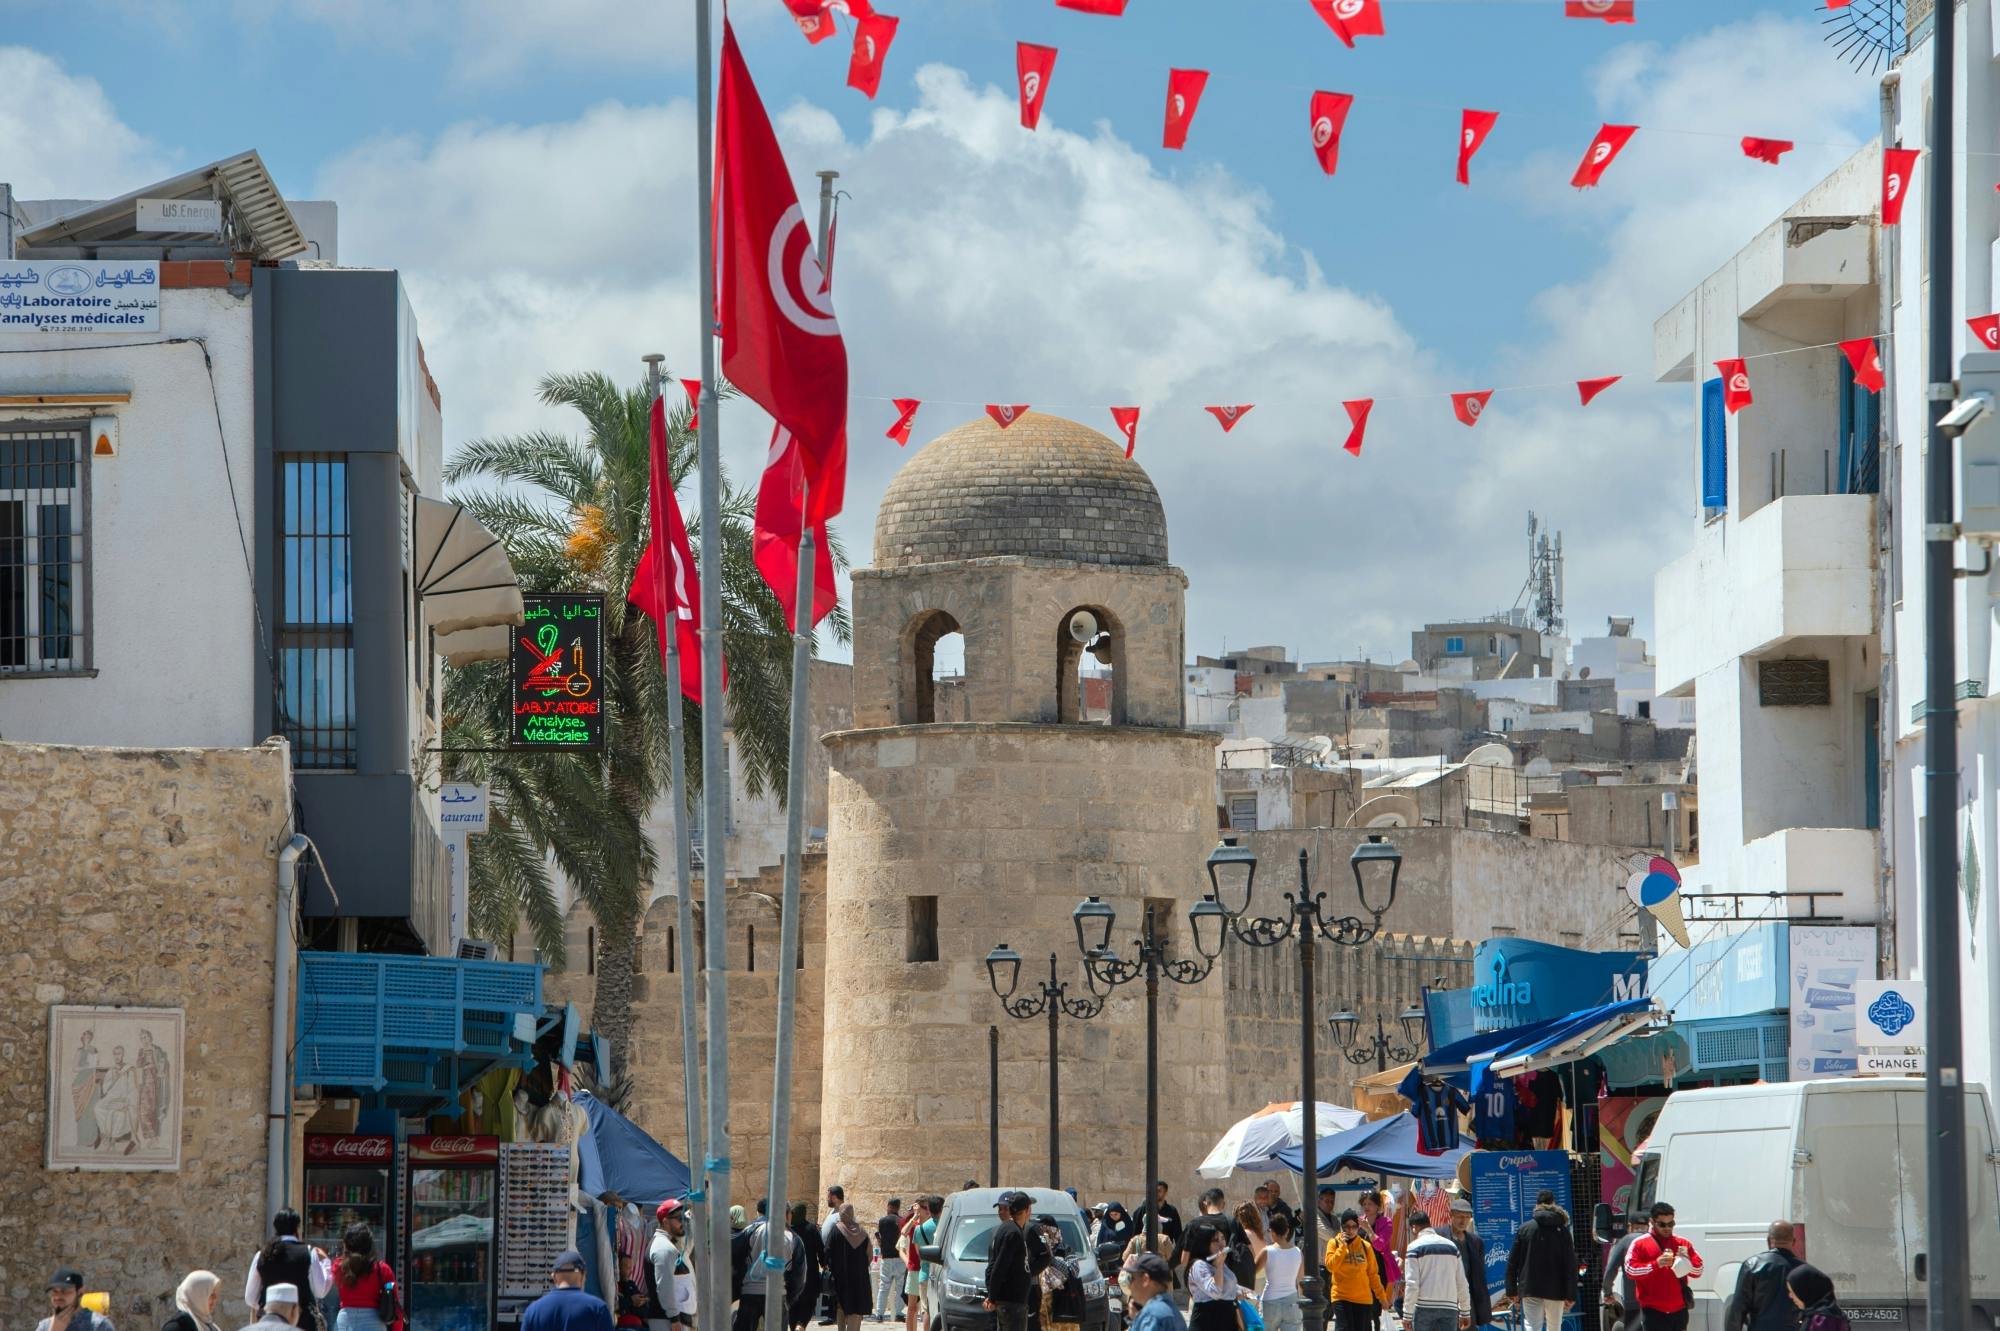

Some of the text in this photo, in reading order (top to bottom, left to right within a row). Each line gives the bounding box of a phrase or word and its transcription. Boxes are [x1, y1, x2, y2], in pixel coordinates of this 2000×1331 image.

[0, 268, 40, 289] طبي
[23, 296, 112, 307] Laboratoire
[0, 313, 145, 327] 'analyses médicales
[523, 605, 550, 620] طبي
[528, 715, 586, 729] Analyses
[441, 813, 484, 823] taurant
[1471, 973, 1531, 1009] medina
[1868, 1058, 1918, 1070] CHANGE
[1485, 1093, 1505, 1118] 10
[333, 1137, 388, 1157] Coca-Cola
[430, 1136, 476, 1153] Coca-Cola
[1874, 1309, 1899, 1320] 4502
